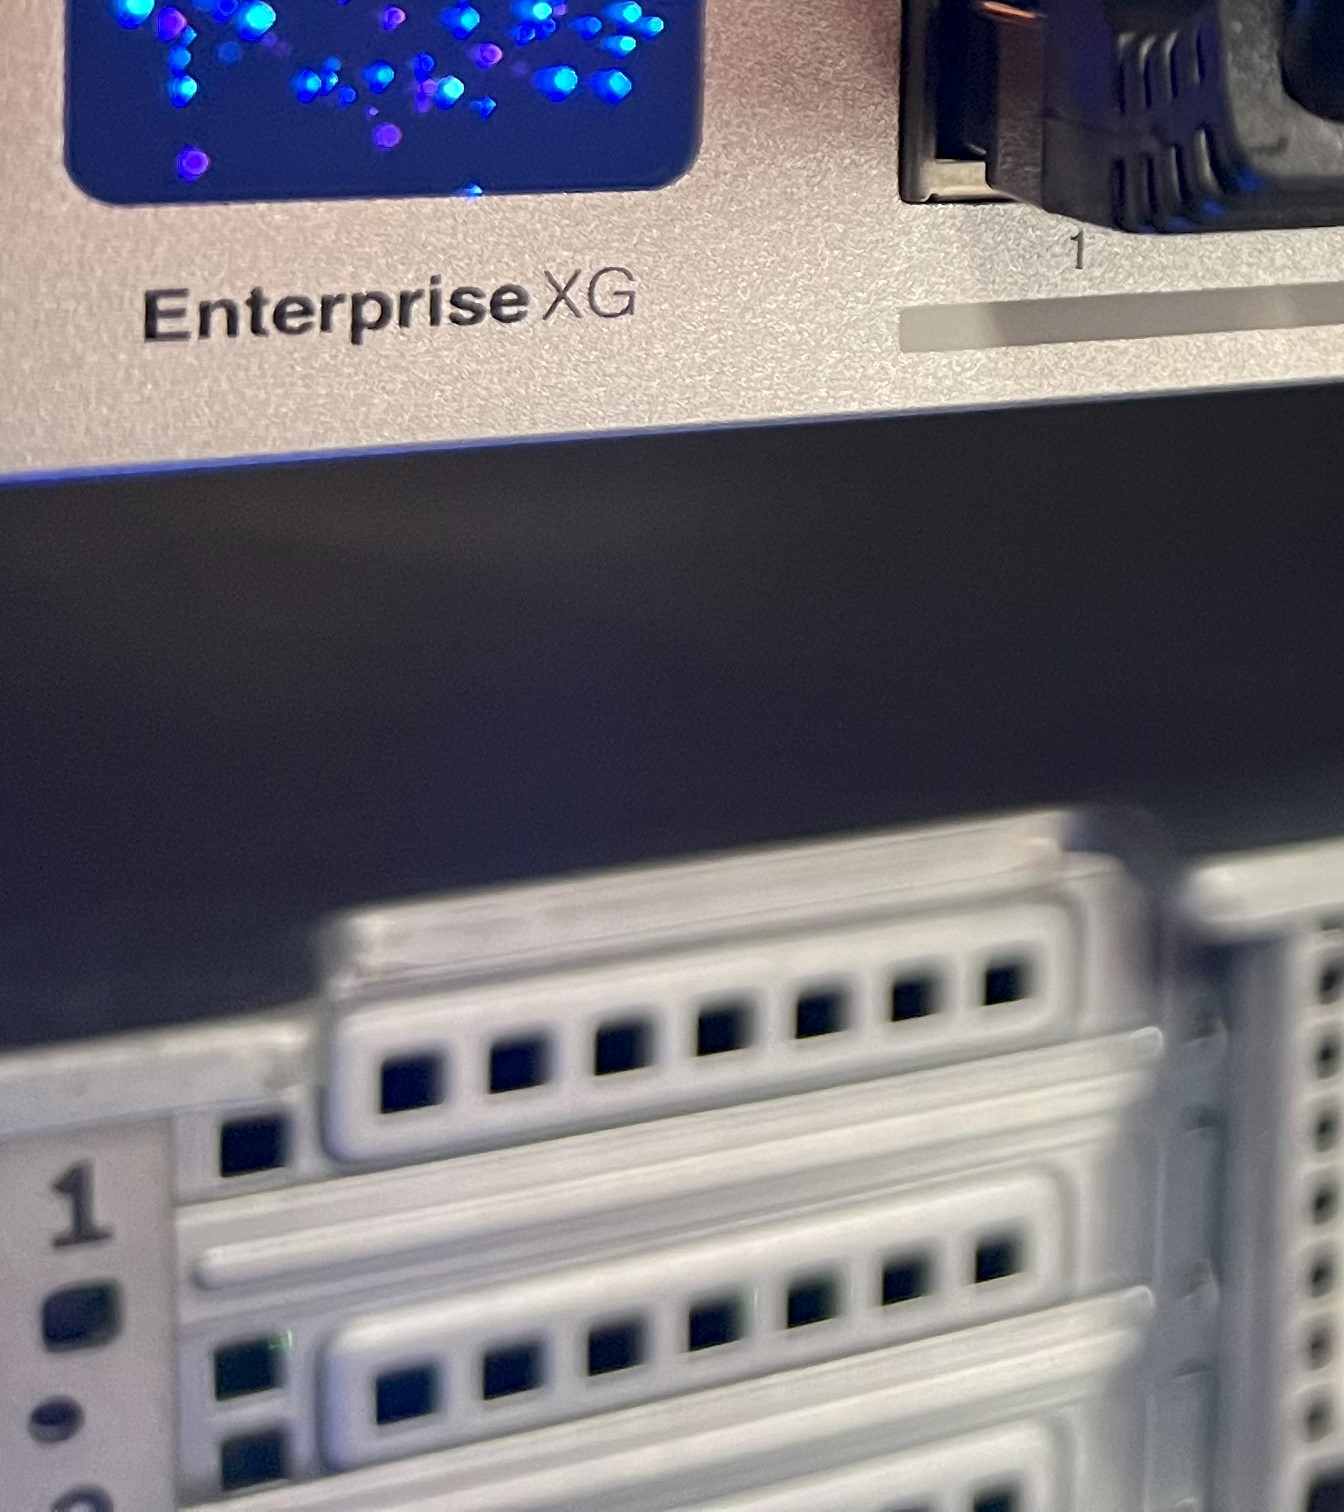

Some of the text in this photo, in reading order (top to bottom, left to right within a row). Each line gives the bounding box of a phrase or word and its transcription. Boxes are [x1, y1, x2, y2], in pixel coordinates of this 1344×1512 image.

[1070, 229, 1085, 270] 1
[144, 265, 637, 346] Enterprise XG
[51, 1157, 115, 1251] 1
